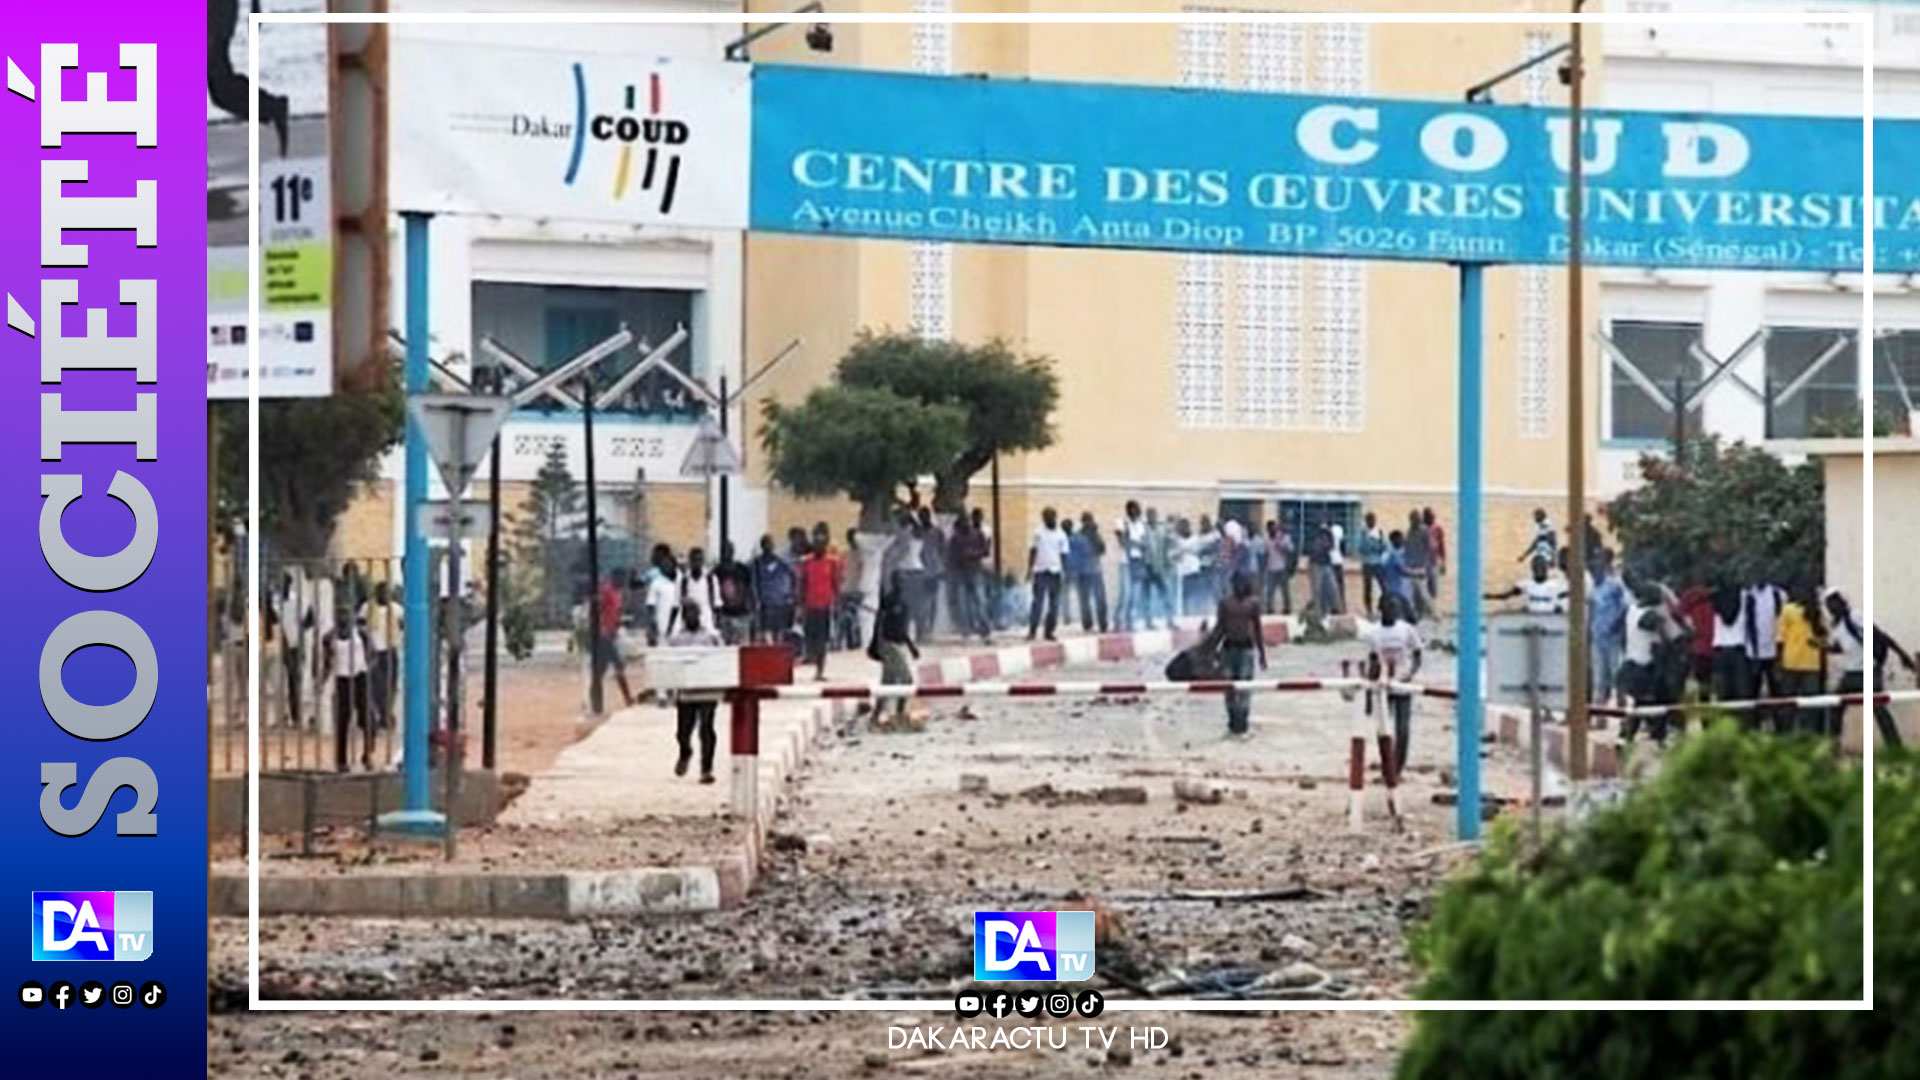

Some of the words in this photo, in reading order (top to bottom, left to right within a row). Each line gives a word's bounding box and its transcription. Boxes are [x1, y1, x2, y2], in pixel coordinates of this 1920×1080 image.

[512, 115, 572, 138] Dakar
[591, 116, 689, 146] COUD
[793, 149, 1077, 199] CENTRE
[1104, 166, 1229, 206] DES
[1248, 174, 1524, 220] ŒUVRES
[793, 200, 924, 229] Avenue
[929, 207, 1057, 236] Cheikh
[1073, 214, 1152, 241] Anta
[1164, 218, 1245, 247] Diop
[1269, 222, 1317, 245] BP
[1337, 226, 1416, 251] 5026
